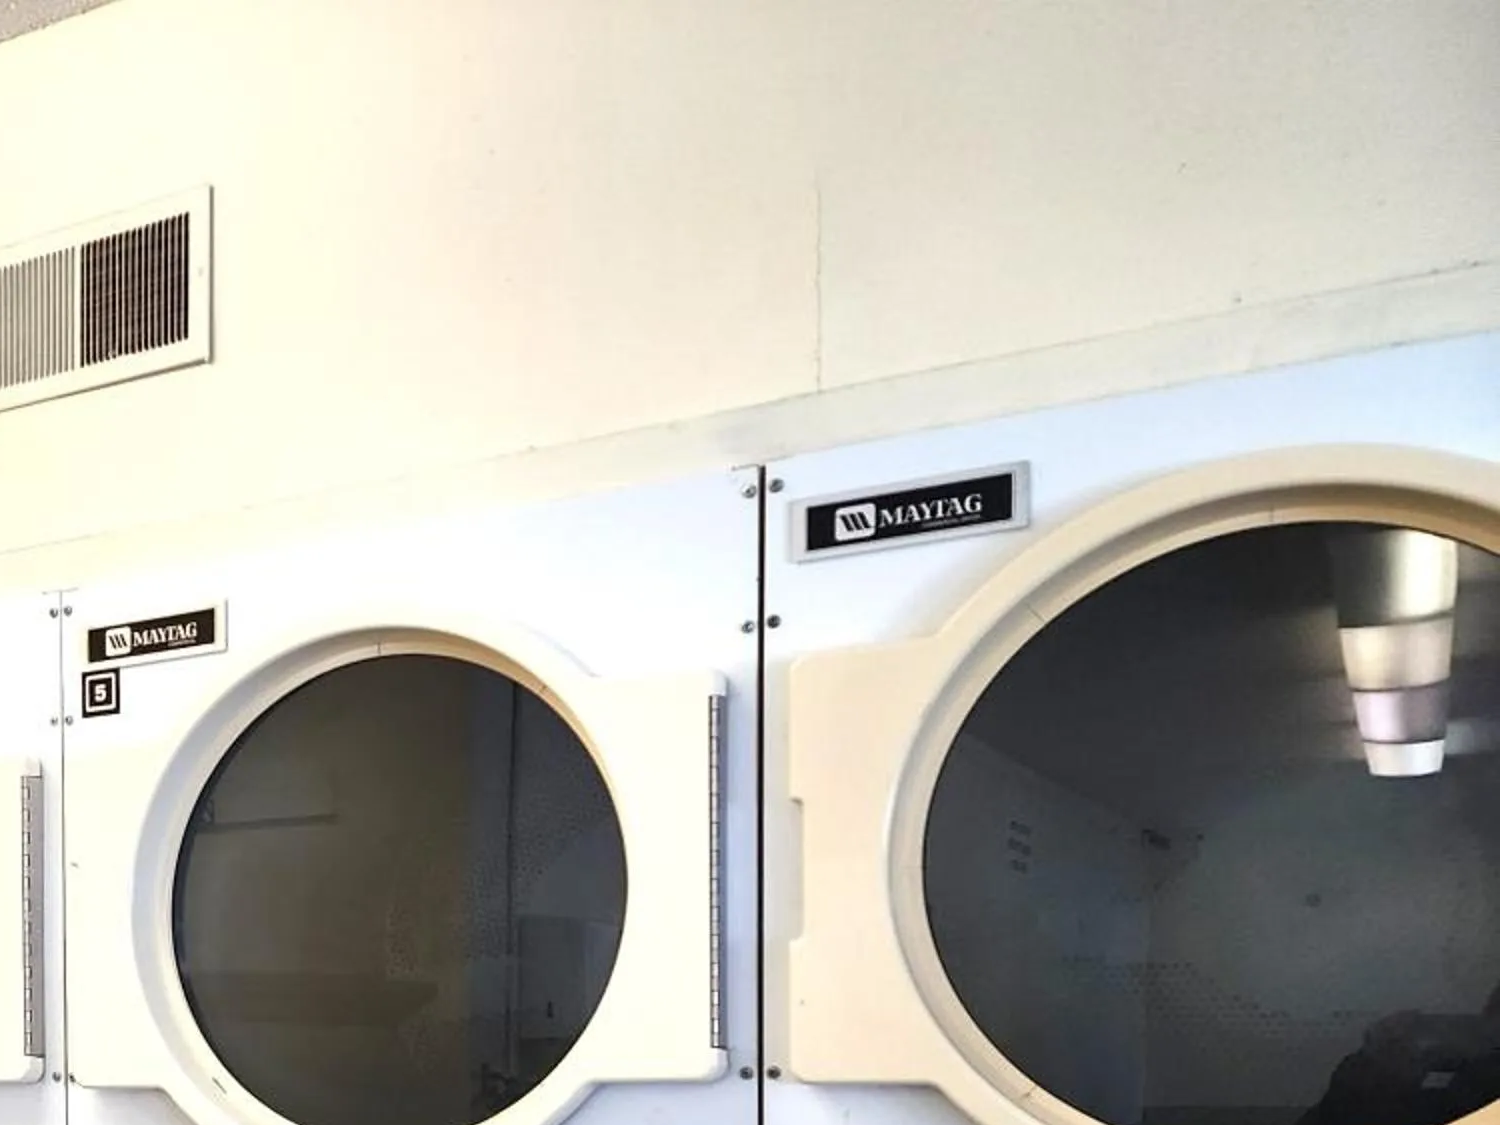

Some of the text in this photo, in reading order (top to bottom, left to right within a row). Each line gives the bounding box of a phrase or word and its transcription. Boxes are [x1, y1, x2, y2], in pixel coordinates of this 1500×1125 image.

[878, 493, 983, 529] MAYTAG
[133, 621, 198, 647] MAYTAG
[94, 683, 107, 702] 5
